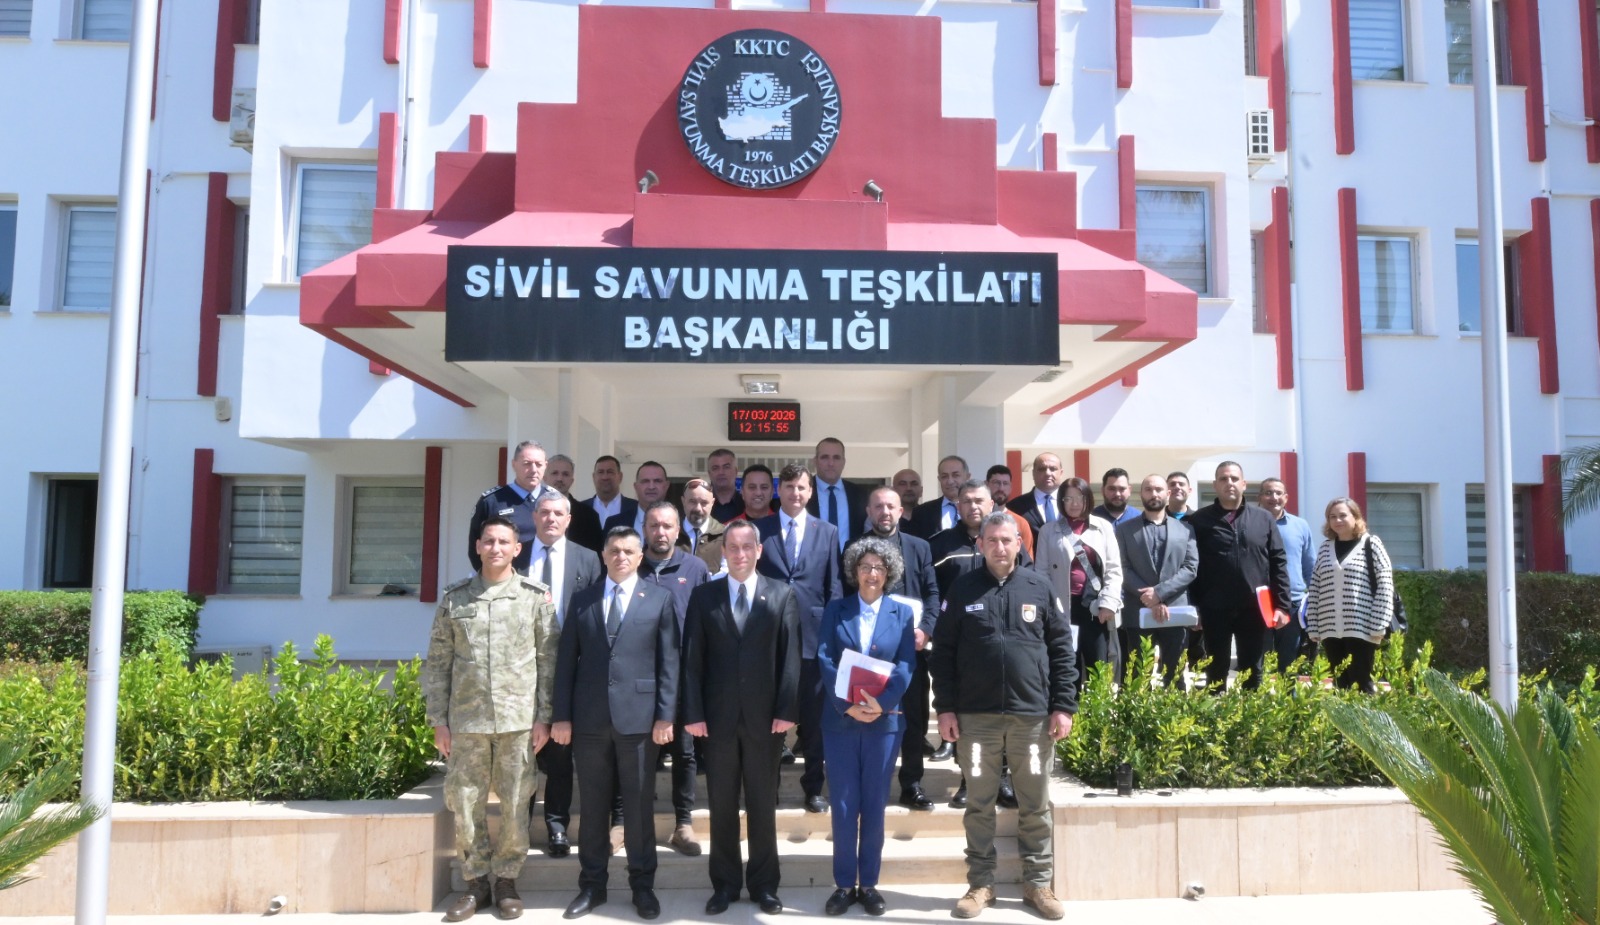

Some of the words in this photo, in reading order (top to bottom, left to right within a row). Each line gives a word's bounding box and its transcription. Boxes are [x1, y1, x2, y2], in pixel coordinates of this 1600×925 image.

[684, 46, 721, 87] SİVİL
[734, 38, 790, 57] KKTC
[800, 50, 840, 155] BAŞKANLIĞI
[680, 90, 725, 174] SAVUNMA
[729, 151, 818, 188] TEŞKİLATI
[744, 150, 773, 163] 1976
[464, 258, 580, 299] SİVİL
[594, 266, 808, 301] SAVUNMA
[822, 263, 1042, 309] TEŞKİLATI
[624, 310, 890, 357] BAŞKANLIĞI
[732, 410, 796, 420] 17/03/2026
